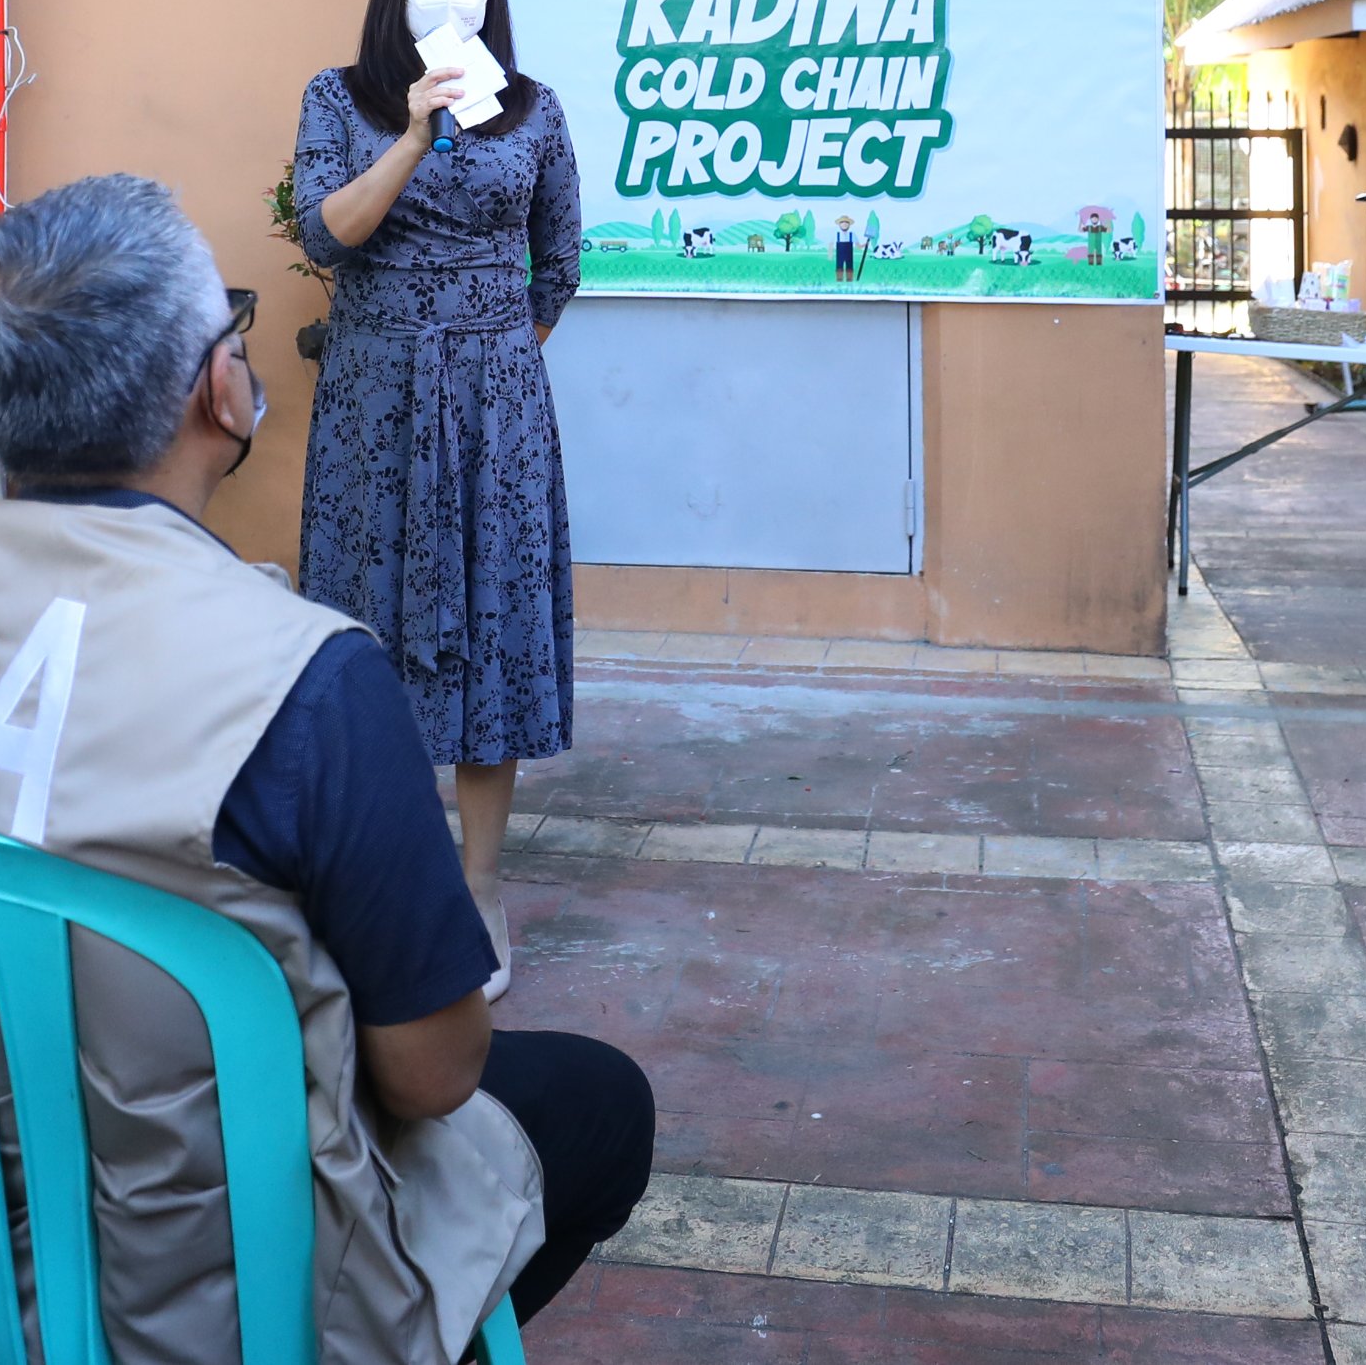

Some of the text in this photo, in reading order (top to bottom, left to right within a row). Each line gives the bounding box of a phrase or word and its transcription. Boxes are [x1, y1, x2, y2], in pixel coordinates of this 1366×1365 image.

[624, 55, 938, 111] COLD CHAIN
[624, 117, 940, 187] PROJECT
